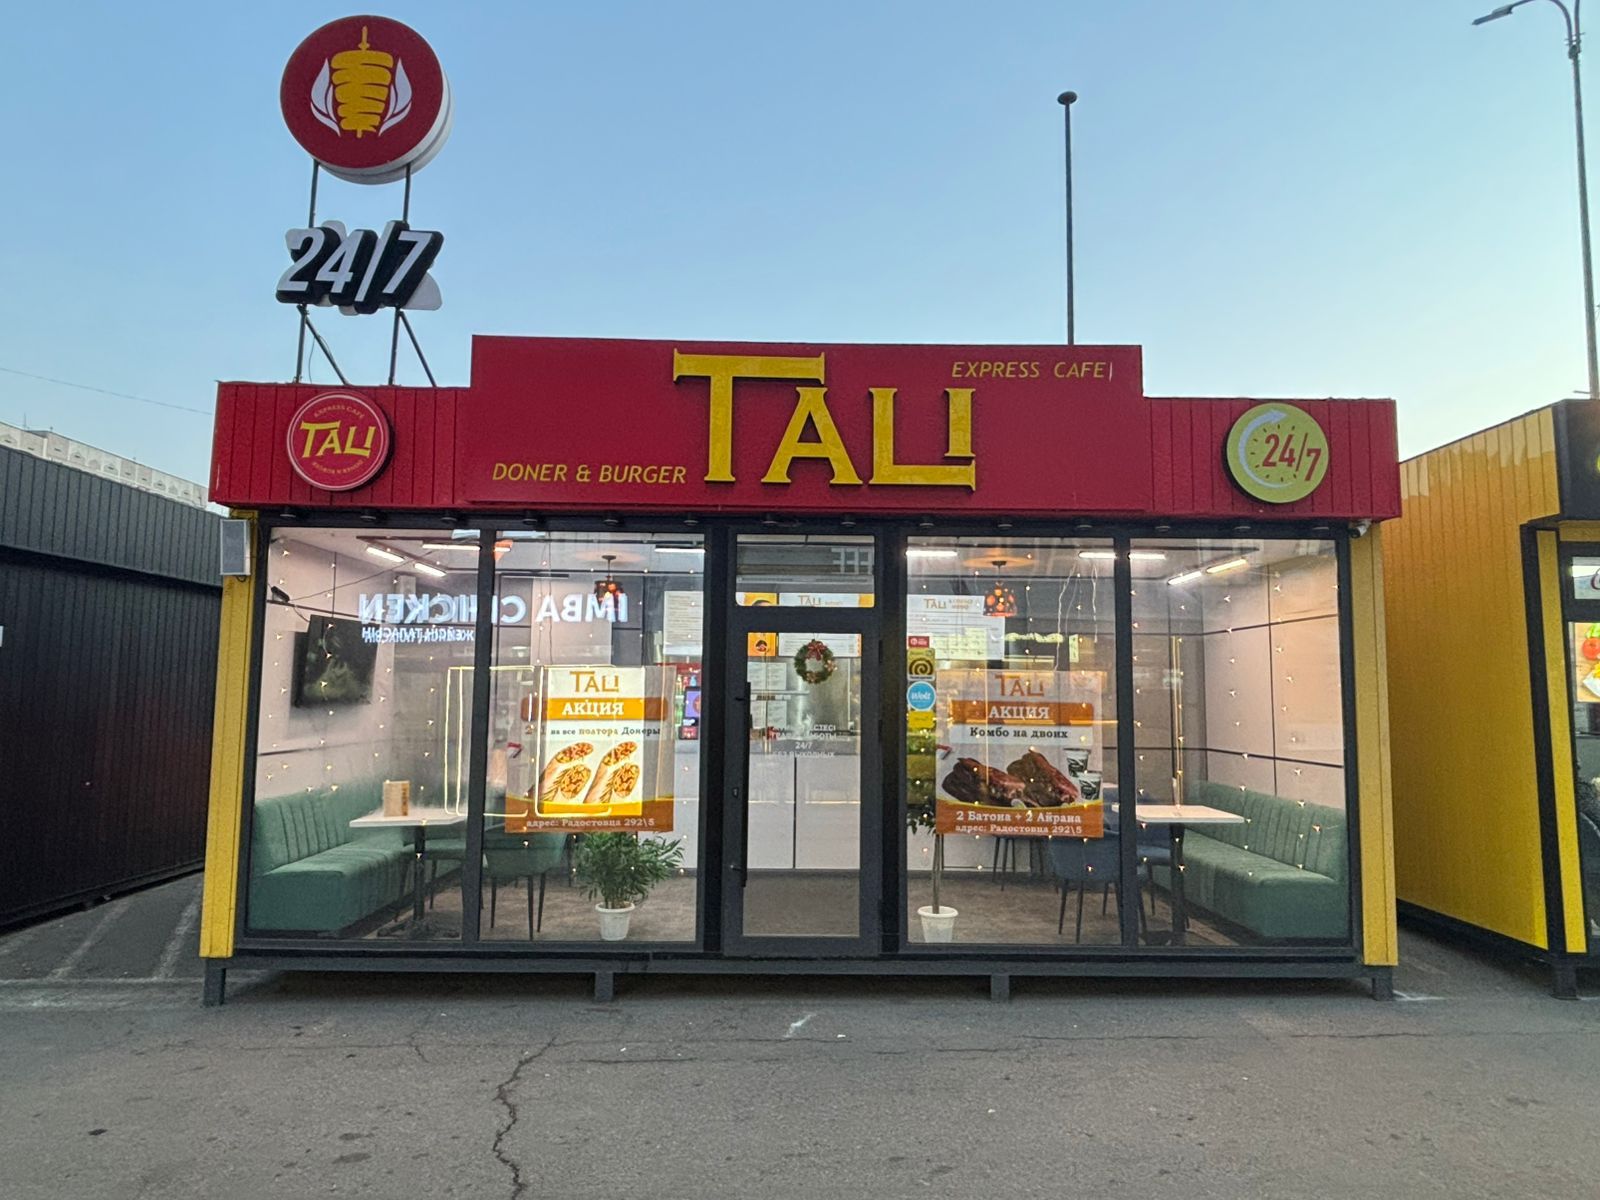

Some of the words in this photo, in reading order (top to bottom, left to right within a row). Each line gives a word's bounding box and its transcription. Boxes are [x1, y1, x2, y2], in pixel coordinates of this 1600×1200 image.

[276, 220, 434, 303] 24/7
[951, 361, 1041, 378] EXPRESS
[1053, 361, 1106, 379] CAFE
[672, 348, 977, 491] TALI
[300, 420, 377, 458] TALI
[1261, 432, 1322, 482] 24/7
[492, 462, 568, 482] DONER
[575, 464, 591, 483] &
[598, 465, 687, 485] BURGER
[570, 670, 620, 693] TALI
[994, 674, 1045, 697] TALI
[562, 701, 625, 717] АКЦИЯ
[988, 705, 1050, 721] АКЦИЯ
[621, 727, 661, 738] Донеры
[969, 726, 1010, 738] Комбо
[1013, 730, 1028, 738] на
[1030, 729, 1069, 740] двоих
[956, 811, 964, 821] 2
[967, 811, 1011, 822] Батона
[1015, 813, 1023, 821] +
[1036, 812, 1082, 826] Айрана
